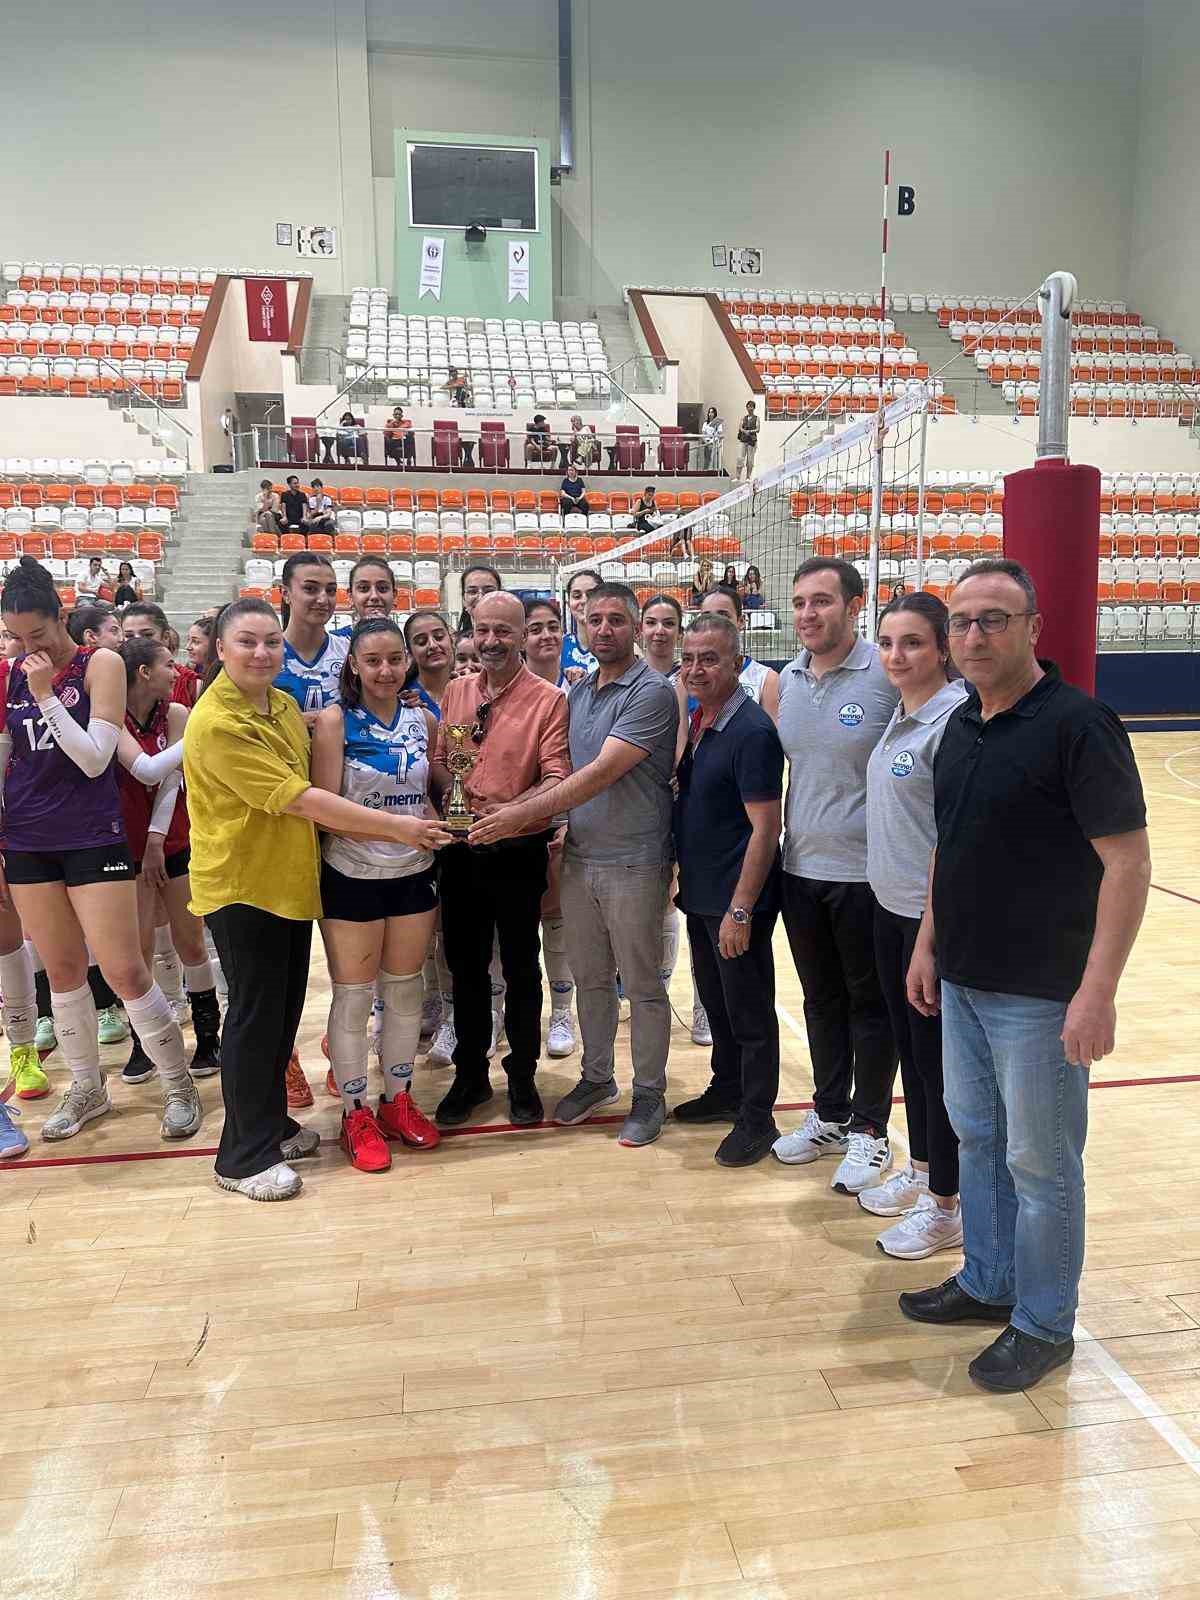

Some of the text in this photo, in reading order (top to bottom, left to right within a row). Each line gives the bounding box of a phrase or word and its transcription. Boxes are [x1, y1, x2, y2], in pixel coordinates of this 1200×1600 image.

[898, 186, 915, 216] B
[22, 718, 55, 751] 12
[388, 744, 408, 784] 7
